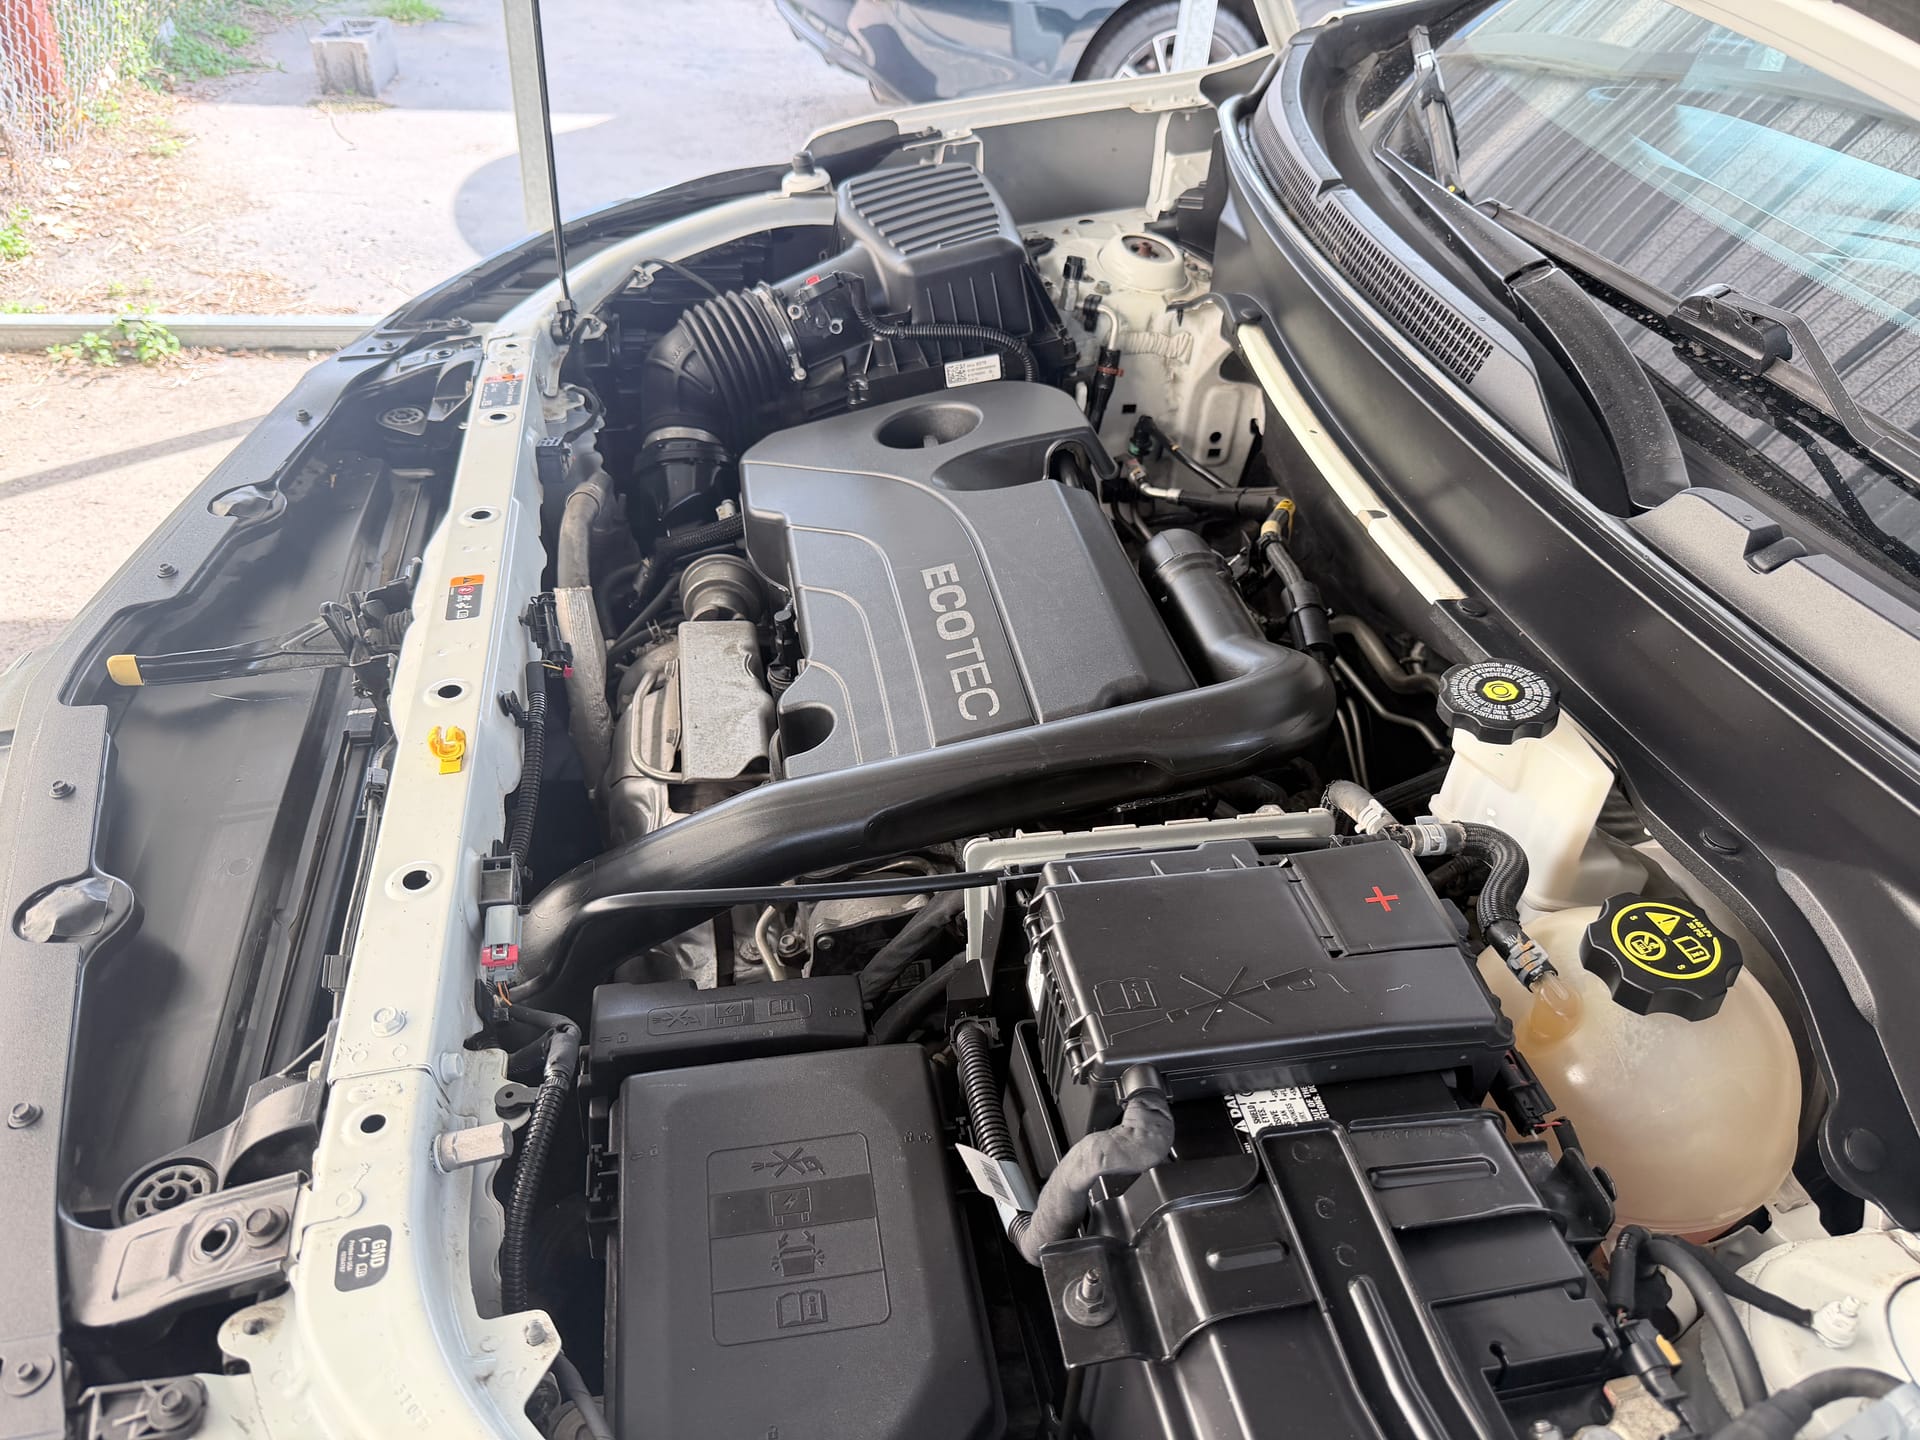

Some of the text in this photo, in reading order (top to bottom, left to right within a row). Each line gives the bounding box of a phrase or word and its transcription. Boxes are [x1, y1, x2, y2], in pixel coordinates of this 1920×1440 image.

[920, 562, 1000, 721] ECOTEC
[1484, 701, 1507, 710] FILLER
[1300, 1086, 1312, 1098] THE
[1308, 1098, 1316, 1108] OF
[1247, 1104, 1262, 1125] SHIELD
[1280, 1109, 1291, 1120] CAN
[370, 1238, 387, 1268] GND
